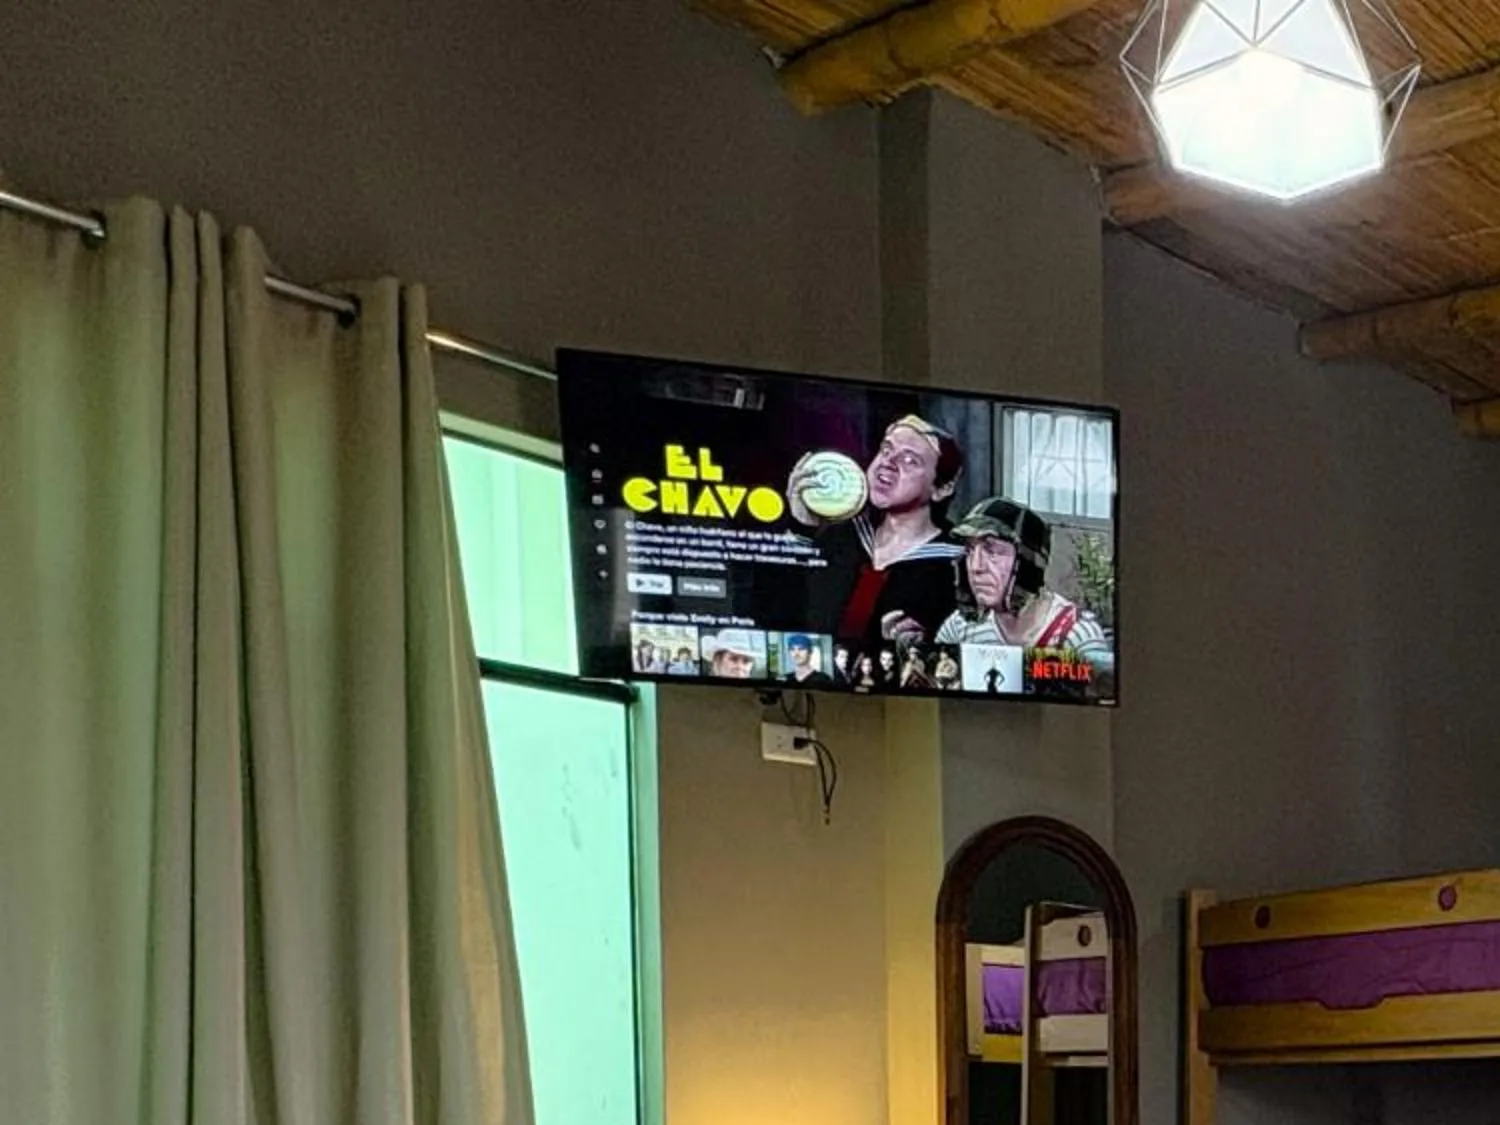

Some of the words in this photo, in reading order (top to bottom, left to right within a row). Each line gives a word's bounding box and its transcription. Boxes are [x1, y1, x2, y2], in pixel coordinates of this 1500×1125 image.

[664, 443, 724, 482] EL
[623, 477, 784, 522] CHAVO
[1032, 660, 1092, 682] NETFLIX
